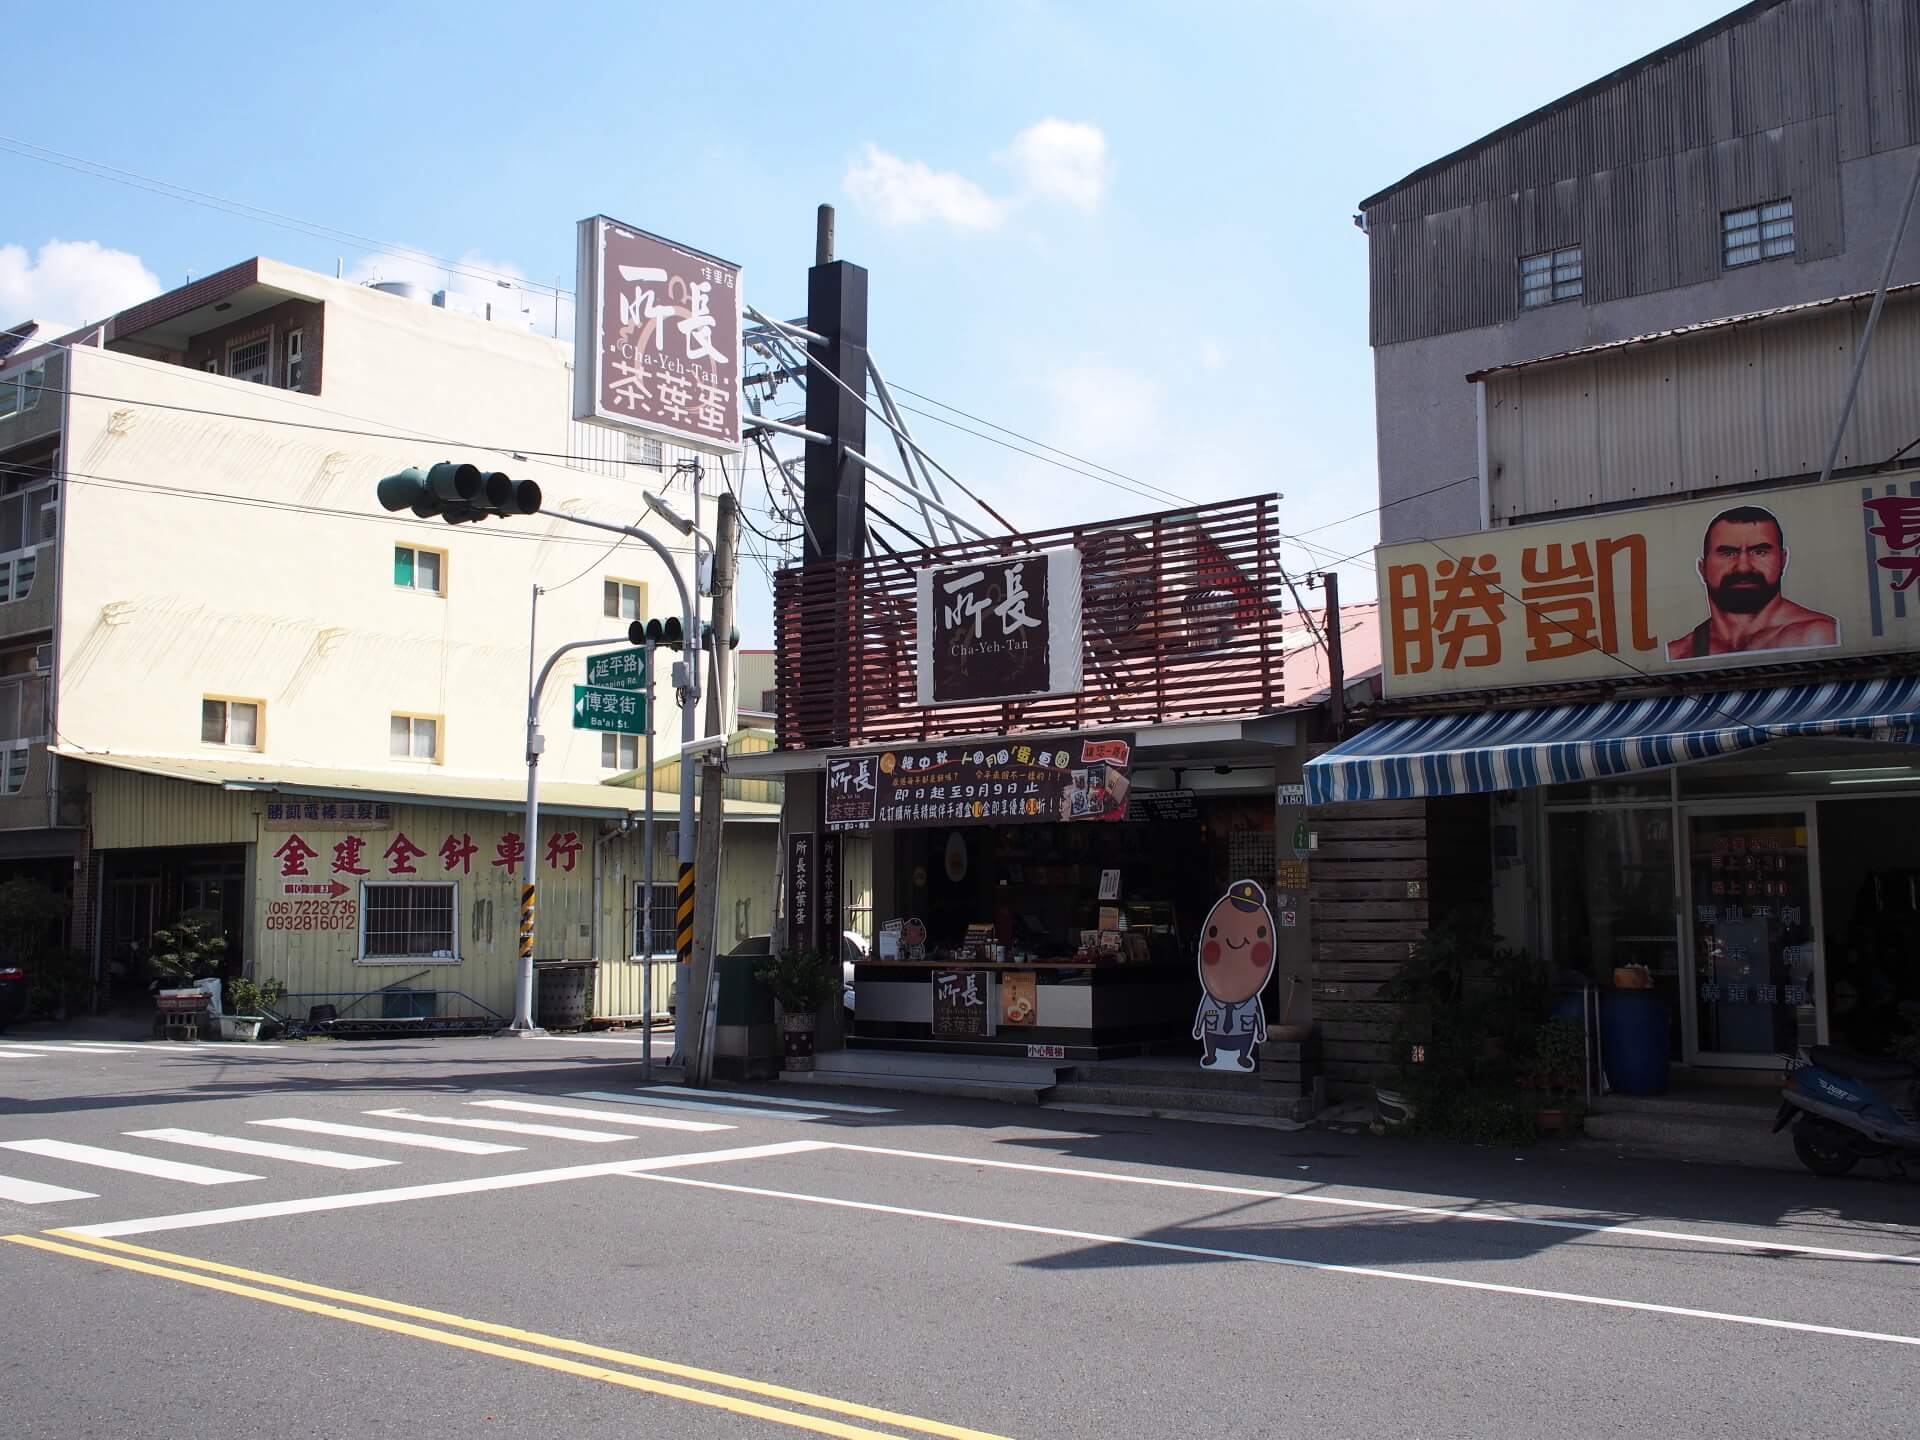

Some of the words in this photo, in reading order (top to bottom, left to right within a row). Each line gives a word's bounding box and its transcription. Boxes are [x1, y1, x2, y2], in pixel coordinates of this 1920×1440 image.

[701, 267, 735, 289] 佳里店
[617, 264, 729, 364] 所長
[621, 343, 719, 385] Cha-Yeh-Tan
[608, 360, 730, 435] 茶葉蛋
[943, 562, 1042, 639] 所長
[1387, 533, 1658, 675] 勝凱
[951, 639, 1029, 657] Cha-Yeh-Tan
[596, 653, 637, 678] 延平路
[584, 691, 636, 715] 博愛街
[591, 717, 614, 727] Ba'ai
[617, 719, 630, 728] St.
[831, 761, 875, 793] 所長
[894, 781, 1040, 802] 即日起至9月9日止
[272, 832, 584, 877] 金建全針車行
[795, 839, 808, 926] 所長茶葉蛋
[824, 840, 835, 926] 所長茶葉蛋
[266, 915, 356, 930] 0932816012
[267, 900, 356, 916] (06)7228736
[938, 973, 984, 1007] 所長
